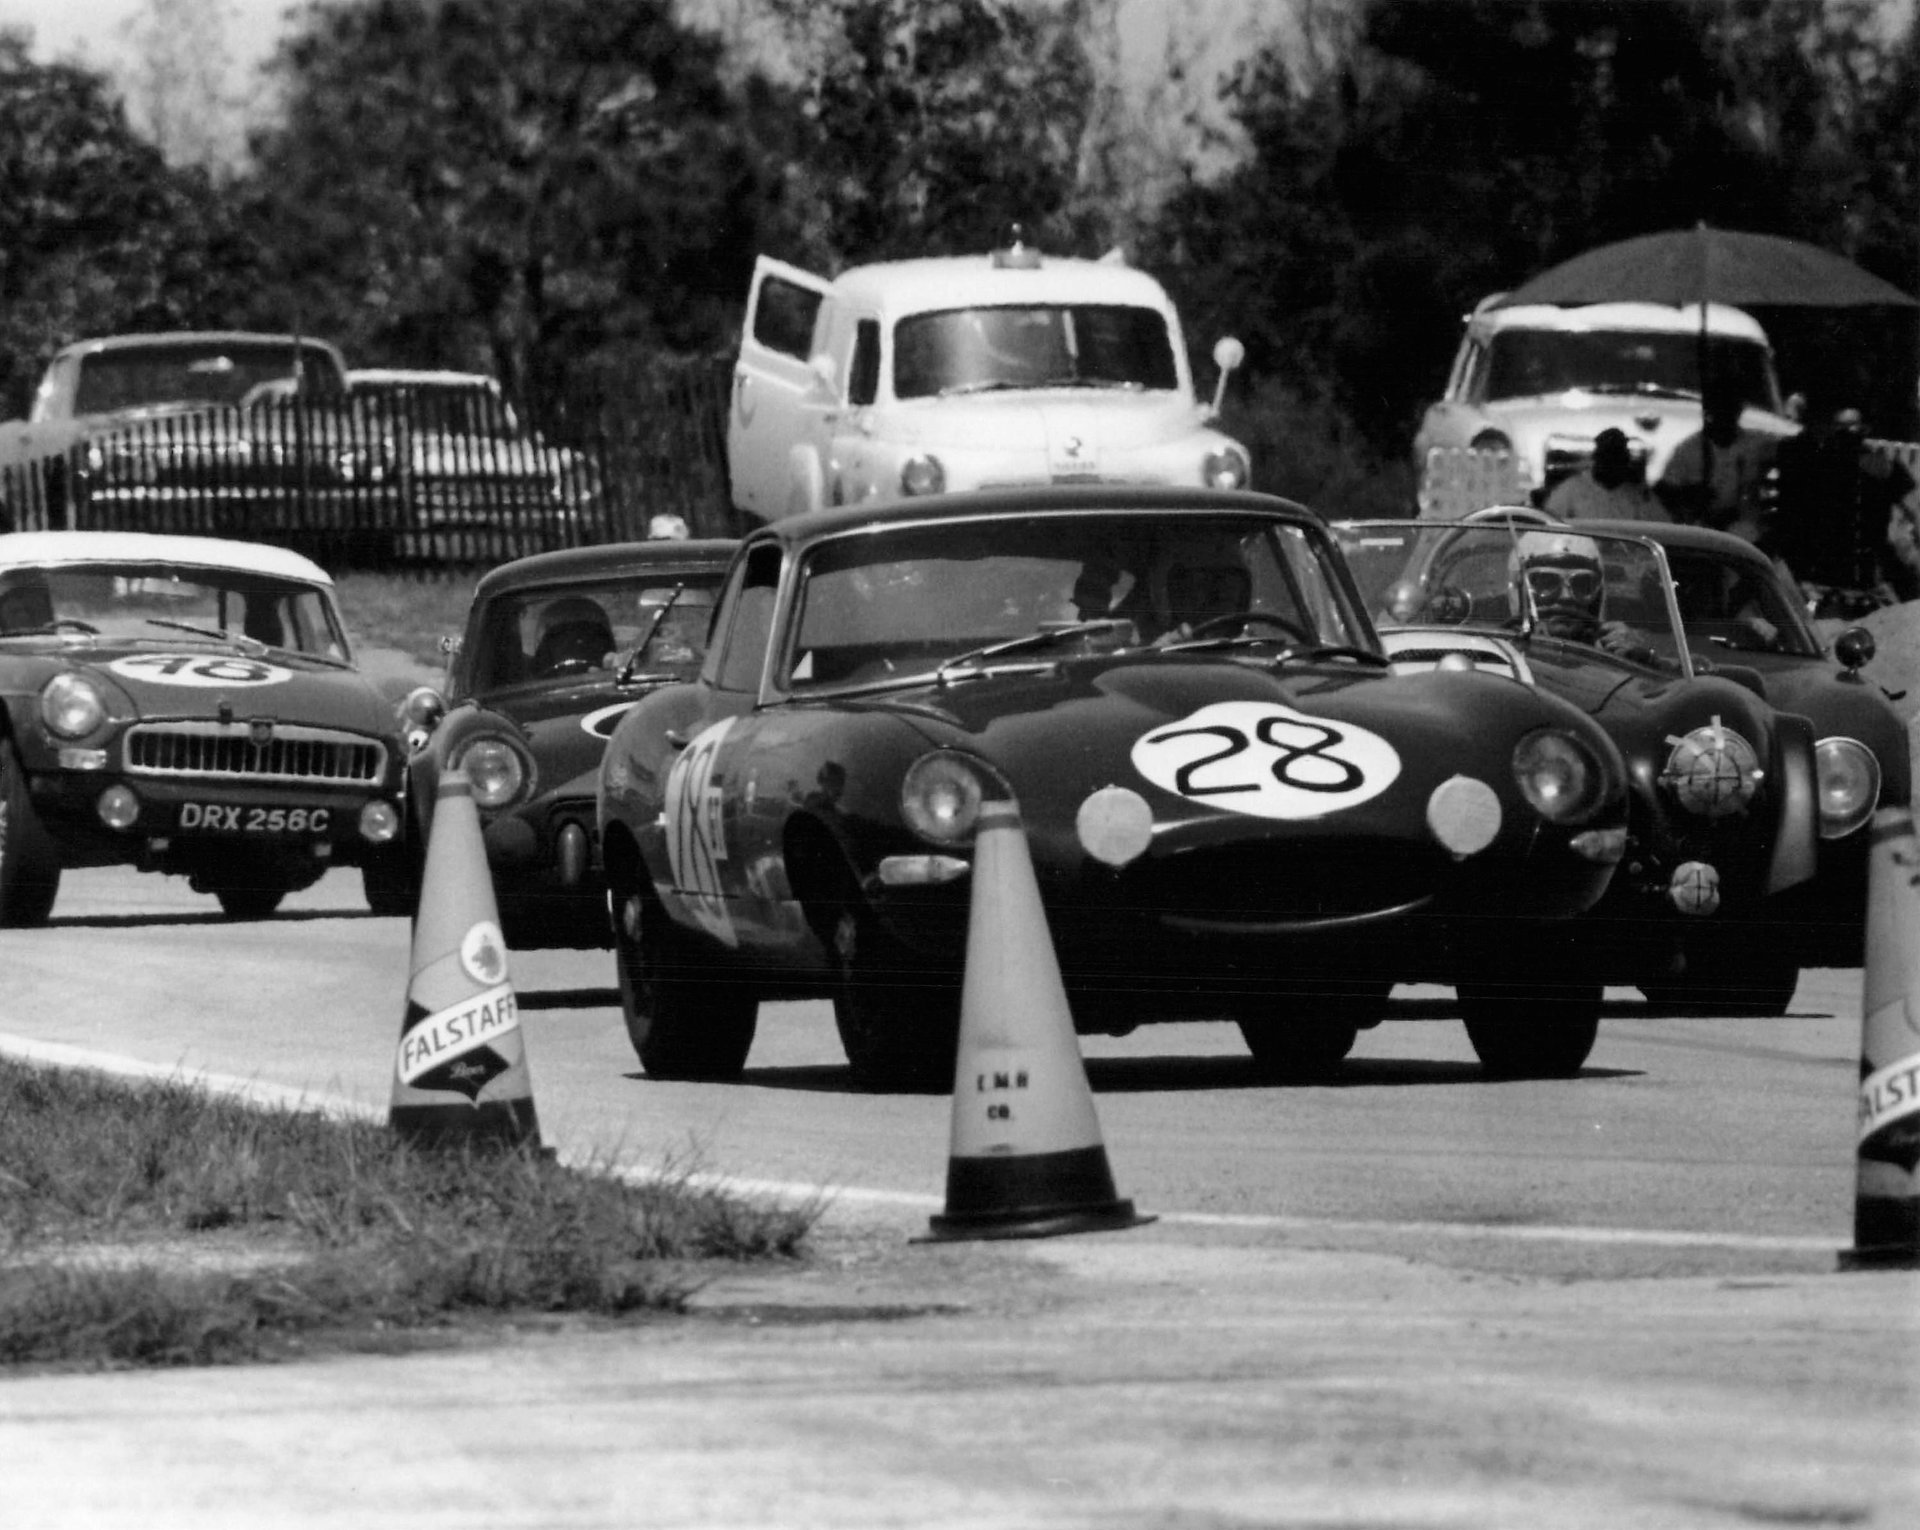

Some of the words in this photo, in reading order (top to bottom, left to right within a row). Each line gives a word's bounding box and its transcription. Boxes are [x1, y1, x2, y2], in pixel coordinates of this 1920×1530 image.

[125, 657, 272, 681] 48
[1147, 717, 1364, 796] 28
[180, 802, 241, 831] DRX
[246, 808, 329, 832] 256C
[404, 994, 514, 1072] FALSTAFF
